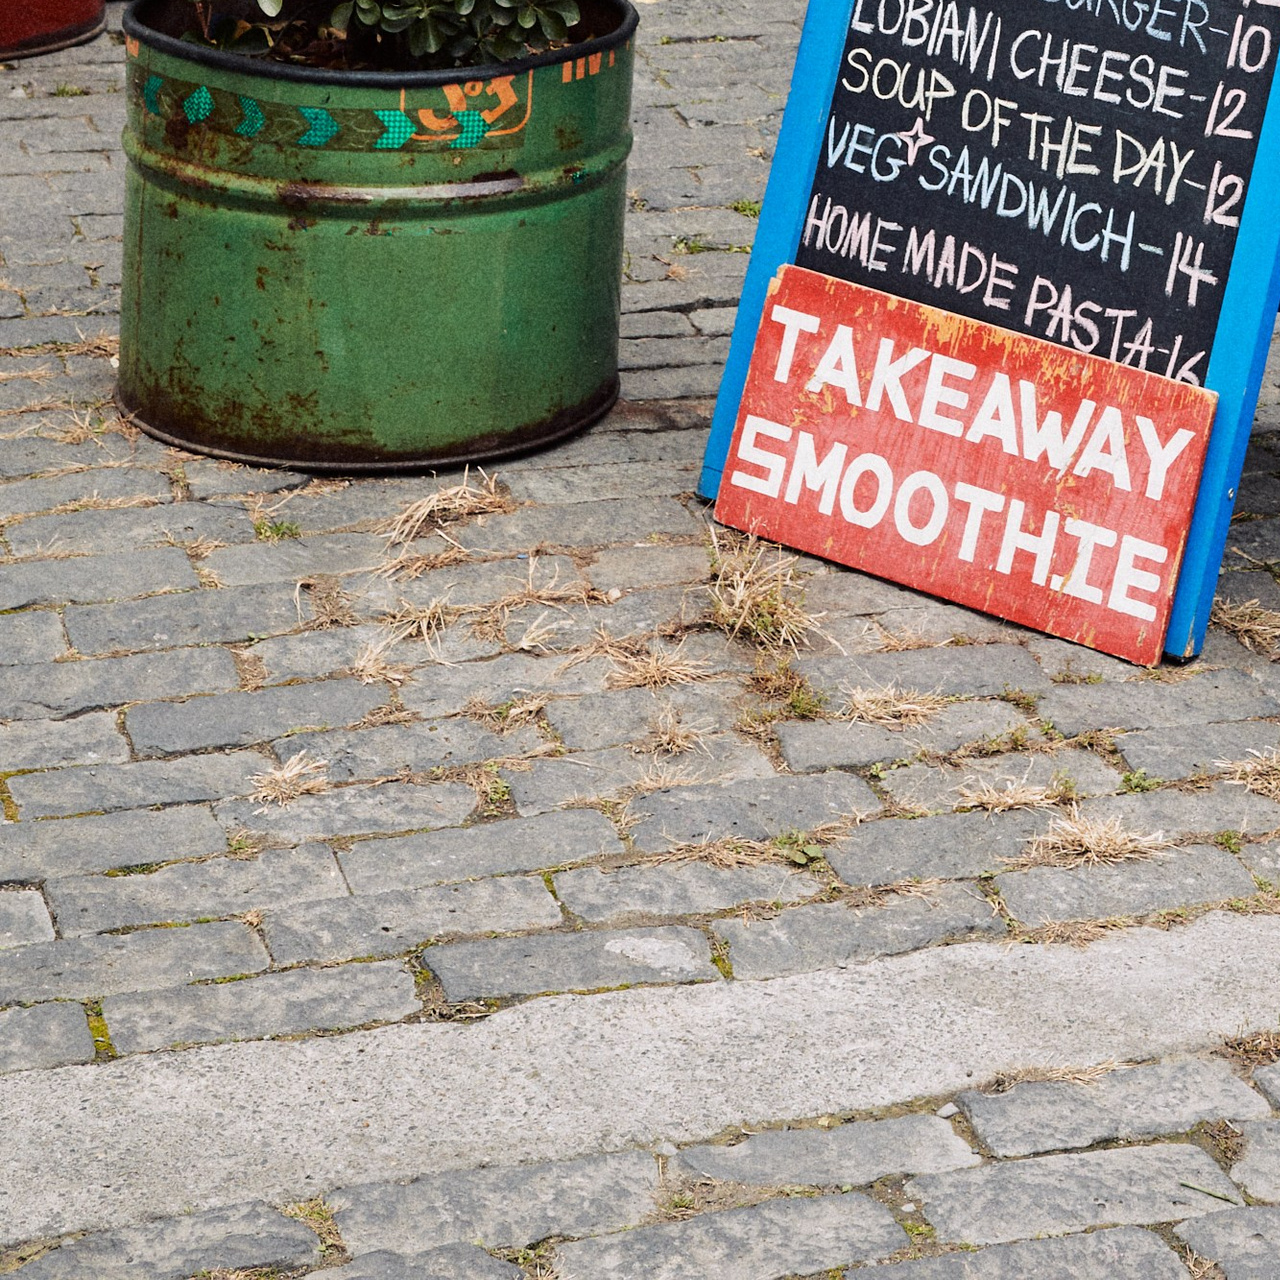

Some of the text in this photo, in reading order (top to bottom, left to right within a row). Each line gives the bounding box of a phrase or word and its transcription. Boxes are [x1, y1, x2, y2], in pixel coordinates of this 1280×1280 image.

[826, 116, 907, 182] VEG
[842, 48, 957, 121] SOUP
[962, 88, 1018, 148] OF
[1020, 111, 1102, 180] THE
[803, 193, 903, 272] HOME
[903, 225, 1018, 310] MADE
[771, 304, 1196, 501] TAKEAWAY
[731, 414, 1168, 622] SMOOTHIE
